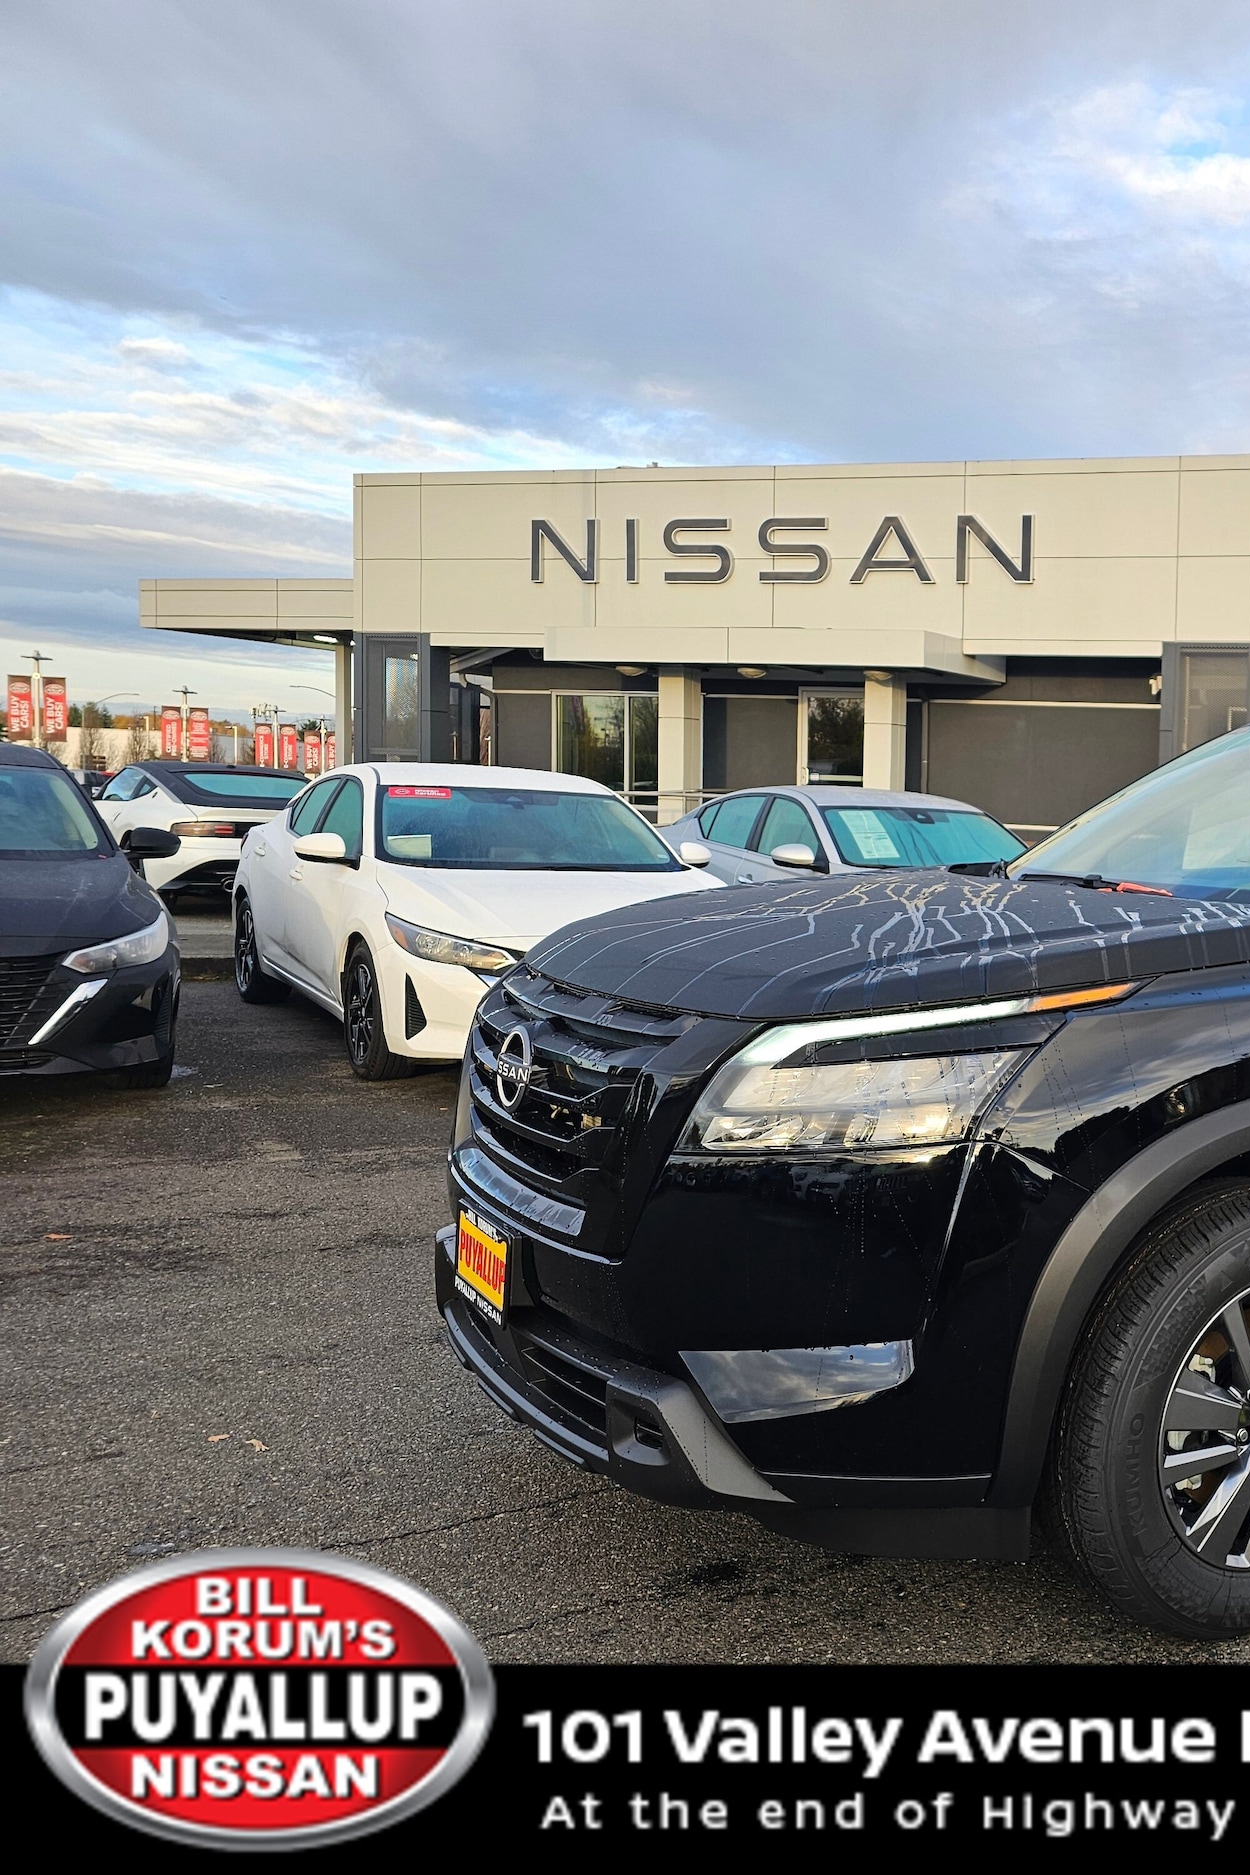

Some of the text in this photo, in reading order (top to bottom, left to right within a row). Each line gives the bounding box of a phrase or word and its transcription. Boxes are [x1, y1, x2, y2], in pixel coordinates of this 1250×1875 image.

[531, 514, 1036, 584] NISSAN
[10, 695, 21, 715] BUY
[20, 700, 30, 728] CARS!
[46, 697, 55, 717] BUY
[54, 701, 64, 730] CARS!
[10, 717, 21, 732] WE
[46, 718, 55, 733] WE
[306, 758, 313, 769] WE
[328, 758, 335, 769] WE
[497, 1060, 528, 1081] SSAN
[460, 1228, 506, 1295] PUYALLUP
[476, 1296, 502, 1326] NISSAN
[1125, 1411, 1147, 1537] KUMHO
